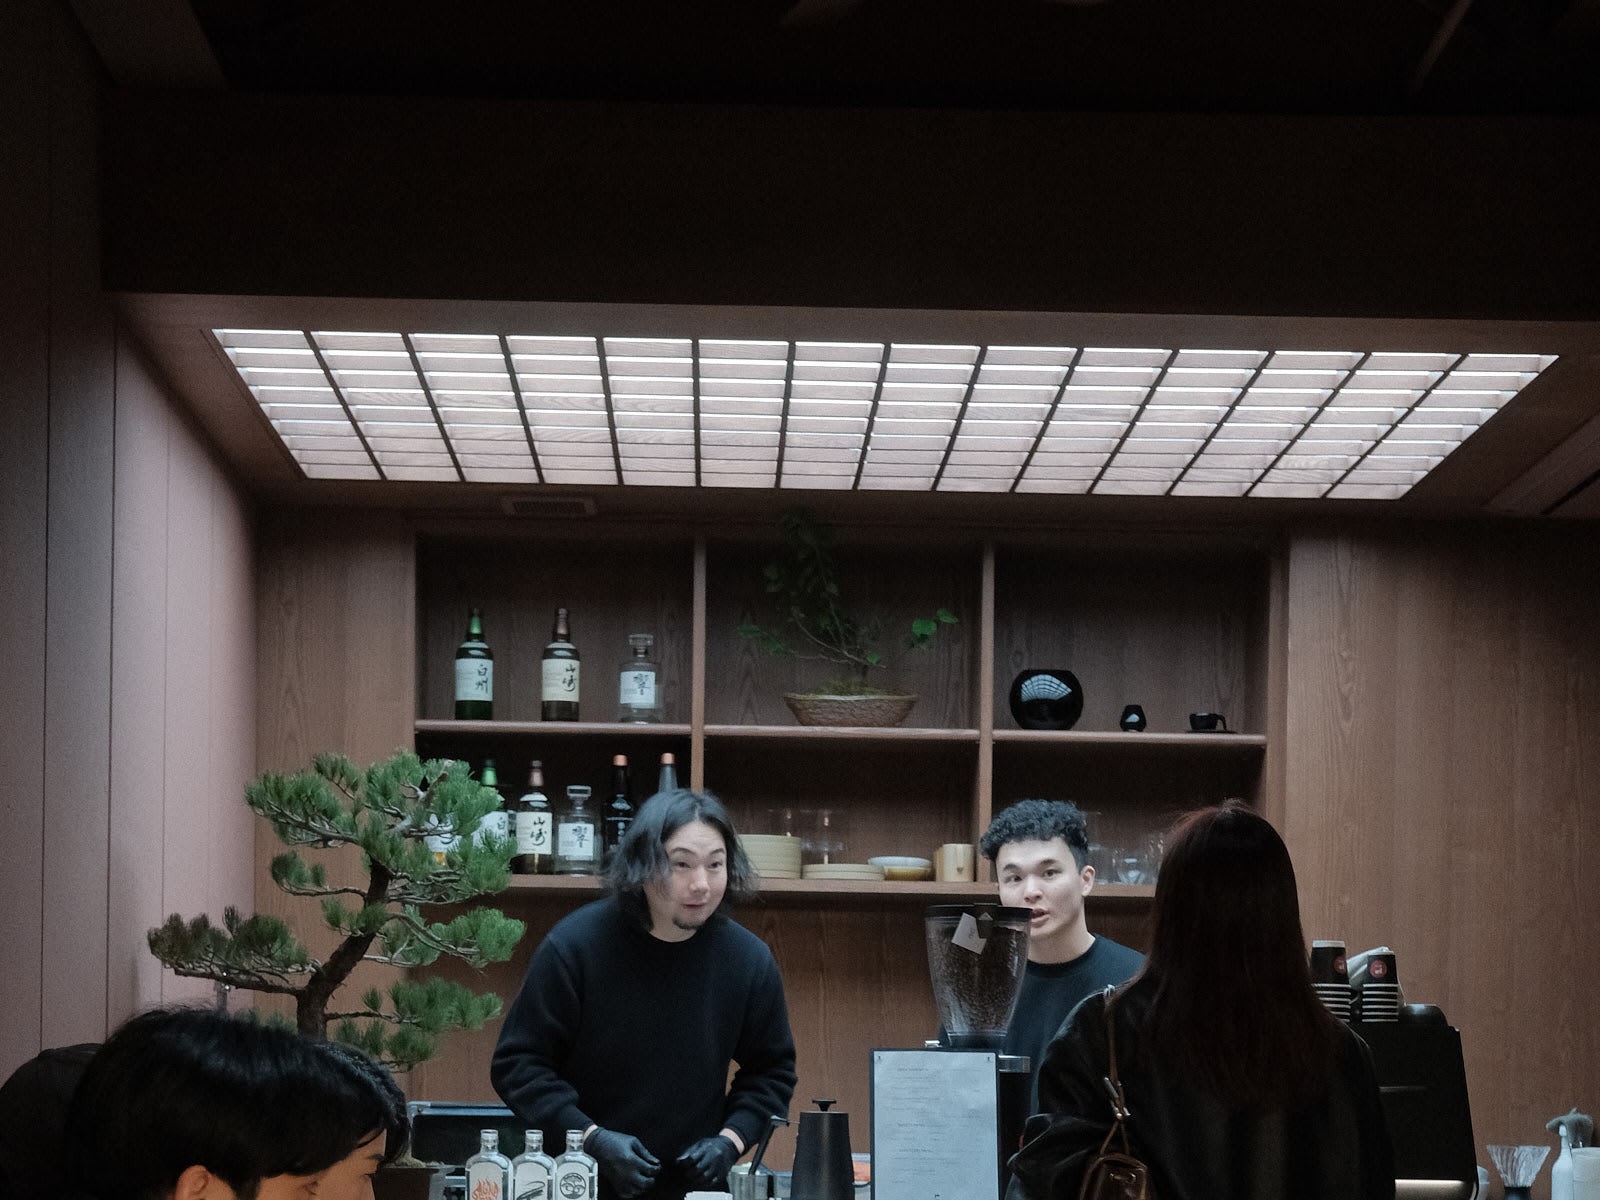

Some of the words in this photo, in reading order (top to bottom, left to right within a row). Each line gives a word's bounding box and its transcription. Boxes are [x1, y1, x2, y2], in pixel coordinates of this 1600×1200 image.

[475, 664, 488, 694] 白州
[562, 664, 577, 692] 山崎
[530, 817, 547, 846] 山崎
